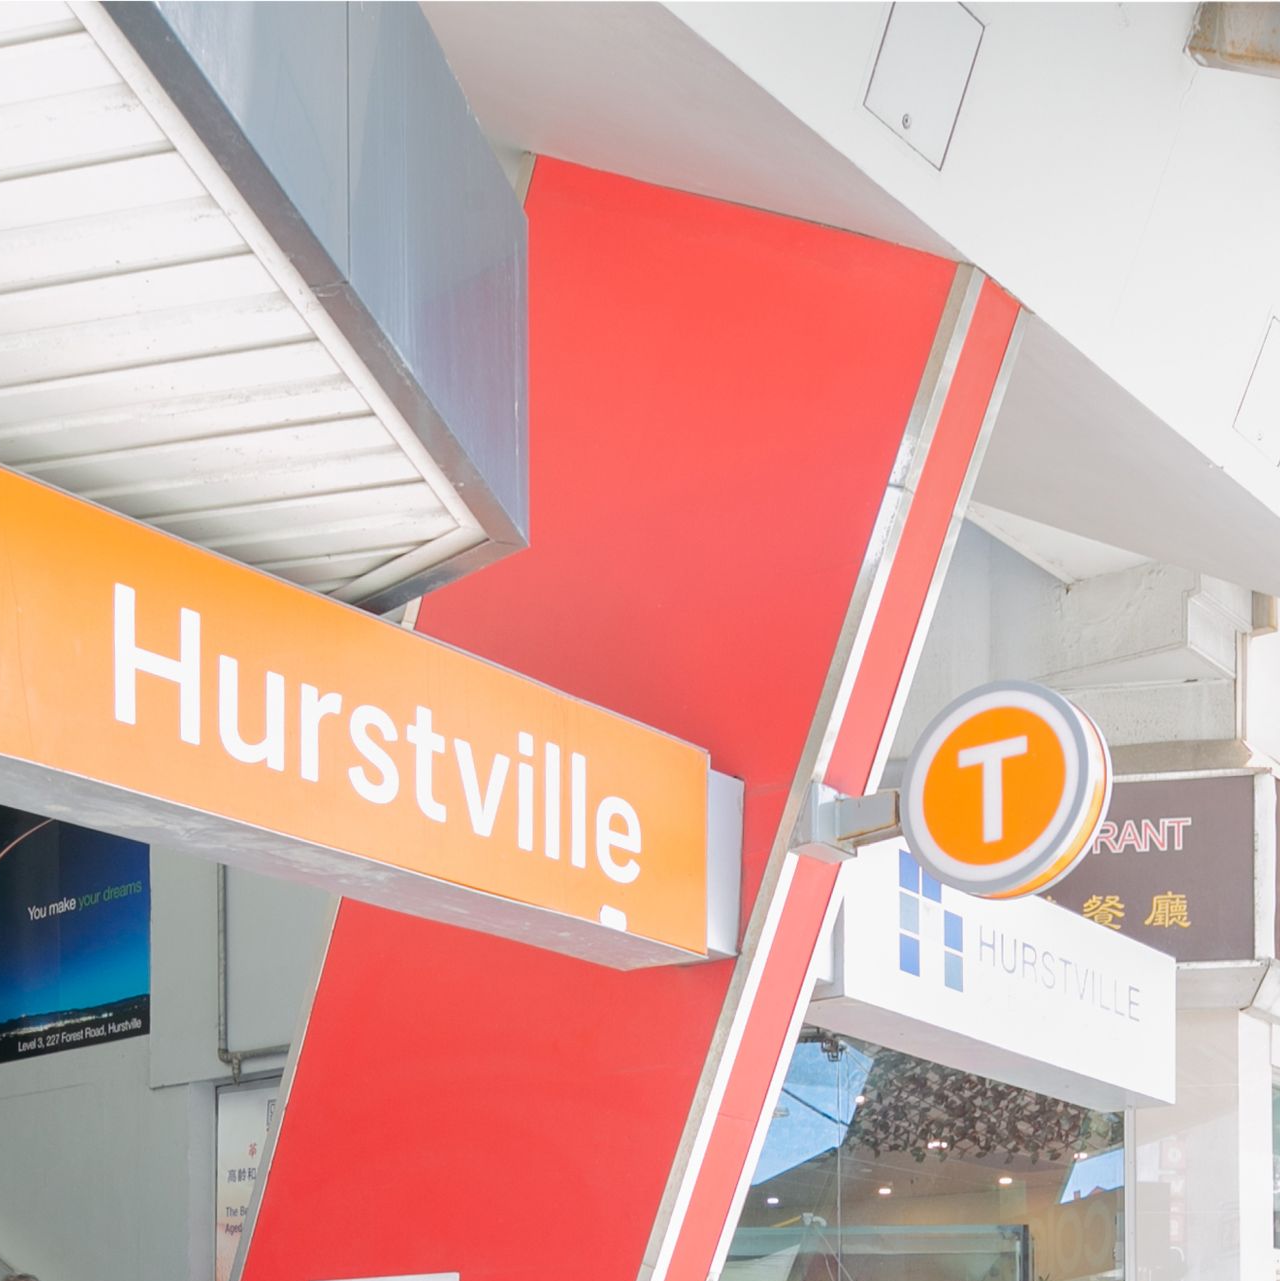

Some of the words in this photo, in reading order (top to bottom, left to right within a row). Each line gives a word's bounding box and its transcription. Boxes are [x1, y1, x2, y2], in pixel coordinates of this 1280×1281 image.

[114, 582, 642, 884] Hurstville
[958, 735, 1028, 844] T
[27, 904, 47, 921] You
[48, 896, 76, 917] make
[78, 892, 101, 910] your
[103, 880, 142, 901] dreams
[978, 924, 1141, 1023] HURSTVILLE
[18, 1039, 38, 1052] Level
[46, 1035, 60, 1048] 227
[61, 1030, 84, 1045] Forest
[85, 1026, 106, 1041] Road,
[108, 1018, 142, 1037] Hurstville
